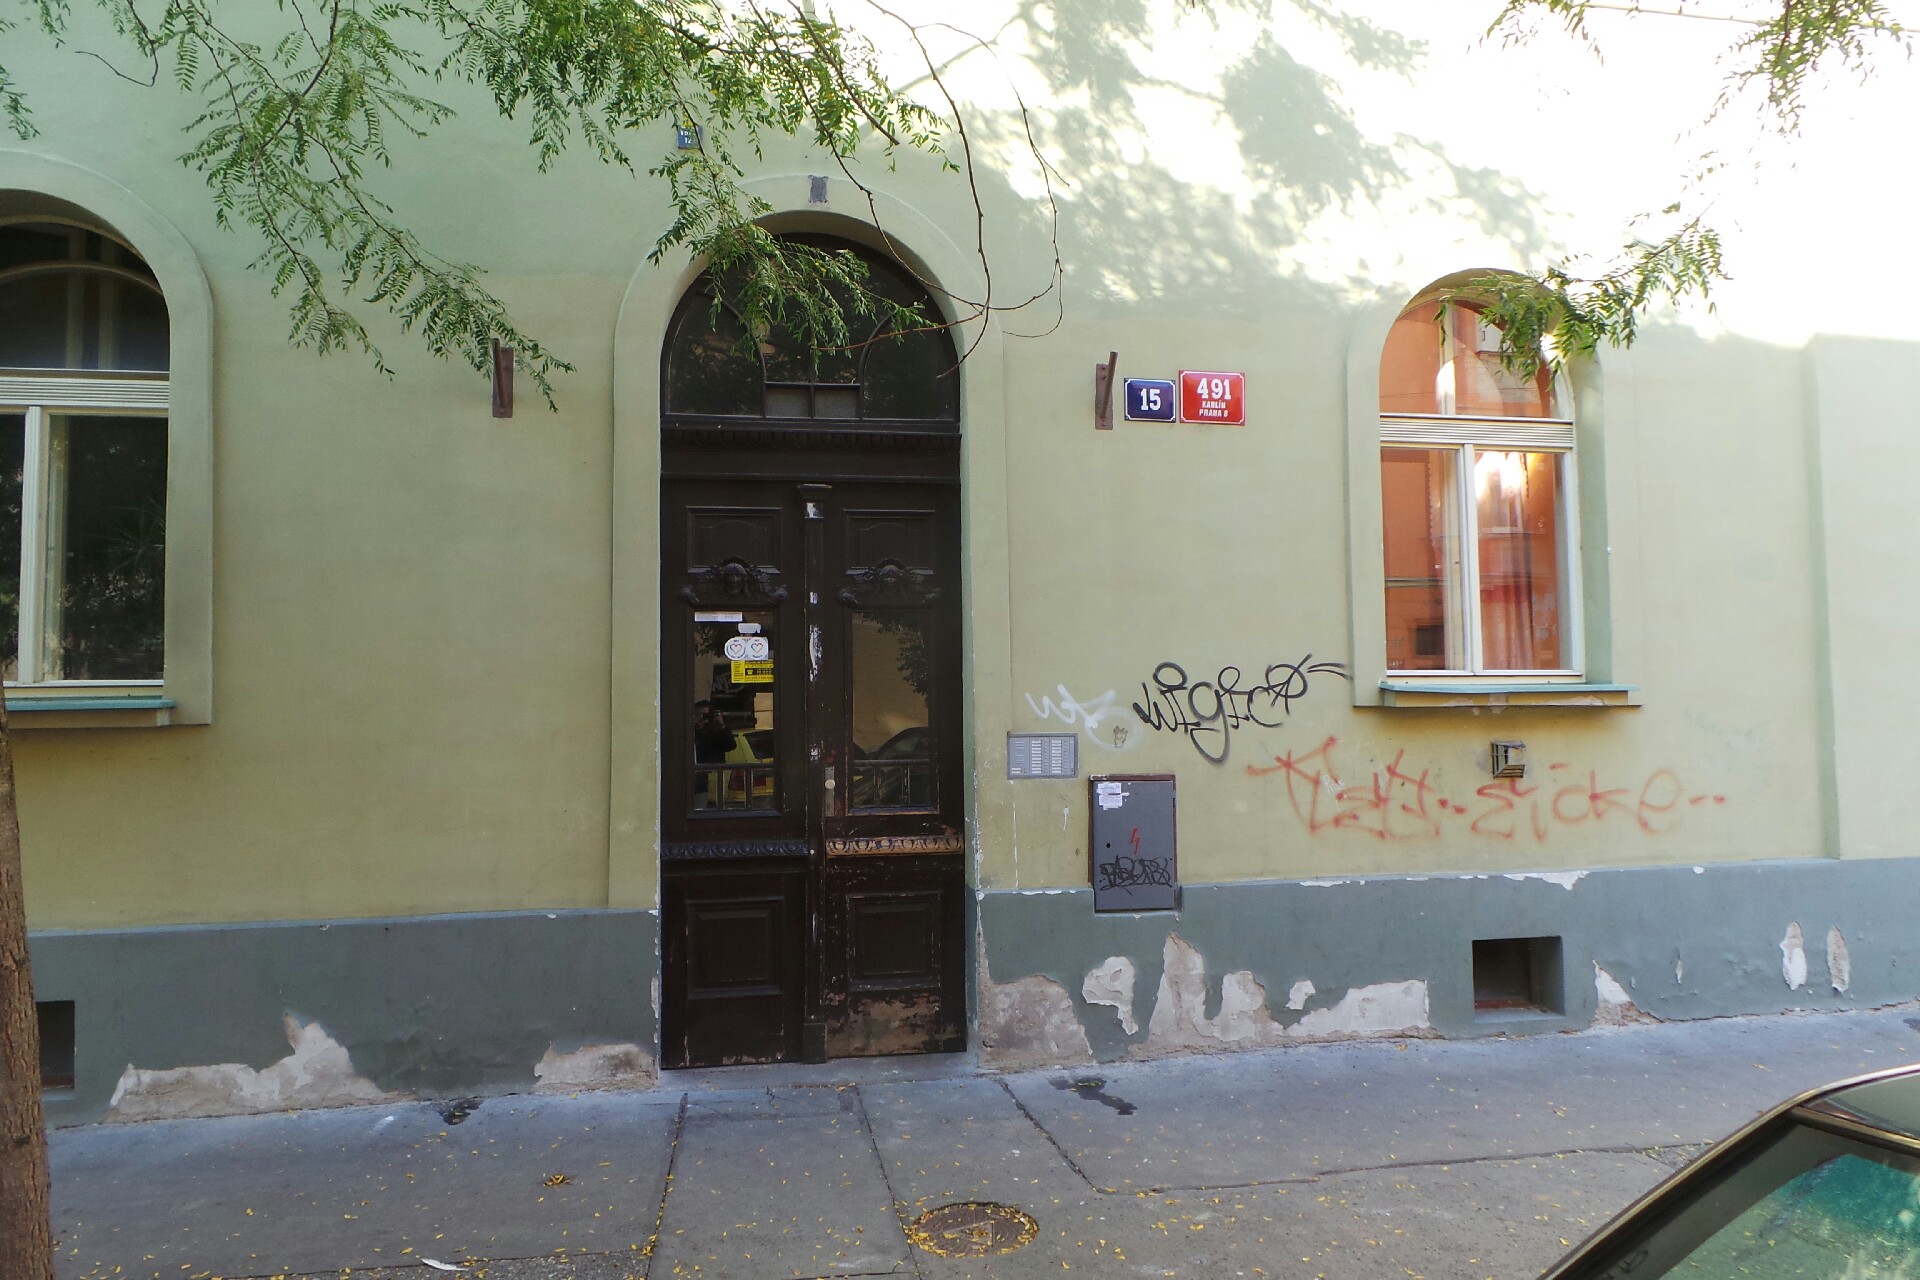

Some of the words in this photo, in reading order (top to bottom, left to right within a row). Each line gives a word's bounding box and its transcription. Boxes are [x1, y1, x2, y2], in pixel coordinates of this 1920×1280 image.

[1140, 388, 1161, 411] 15
[1197, 377, 1232, 400] 491
[1199, 408, 1222, 417] PRAHA
